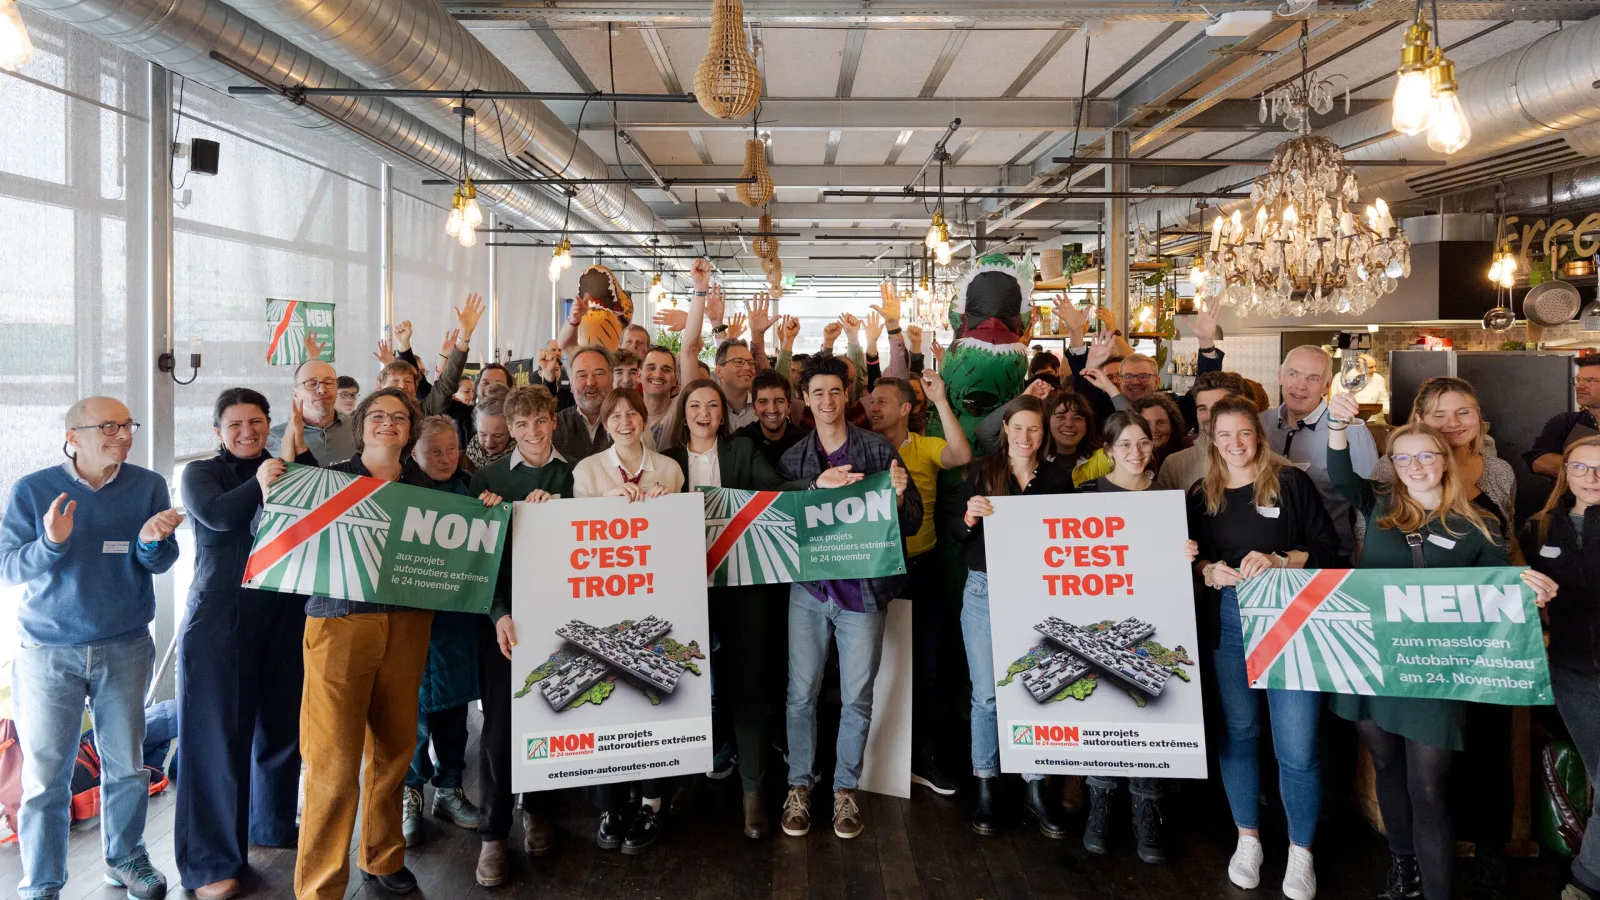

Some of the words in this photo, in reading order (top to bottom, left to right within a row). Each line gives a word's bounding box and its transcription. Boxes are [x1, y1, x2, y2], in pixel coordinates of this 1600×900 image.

[305, 309, 332, 327] NEIN
[804, 489, 892, 529] NON
[400, 506, 501, 555] NON
[571, 517, 649, 541] TROP
[1042, 516, 1125, 540] TROP
[809, 534, 824, 542] aux
[825, 532, 853, 543] projets
[810, 542, 859, 552] autoroutiers
[860, 540, 896, 550] extrêmes
[396, 552, 413, 561] aux
[413, 554, 445, 566] projets
[570, 545, 652, 570] C'EST
[810, 554, 818, 563] le
[819, 554, 830, 562] 24
[831, 553, 871, 562] novembre
[1043, 545, 1129, 568] C'EST
[391, 574, 400, 584] le
[401, 576, 413, 585] 24
[414, 579, 460, 591] novembre
[393, 564, 448, 578] autoroutiers
[450, 572, 489, 583] extrêmes
[568, 573, 654, 598] TROP!
[1042, 573, 1134, 596] TROP!
[1383, 584, 1526, 624] NEIN
[1391, 637, 1424, 647] zum
[1427, 636, 1511, 649] masslosen
[1396, 653, 1535, 670] Autobahn-Ausbau
[1399, 673, 1423, 684] am
[1425, 672, 1449, 684] 24.
[1452, 672, 1536, 690] November
[550, 732, 595, 752] NON
[597, 734, 616, 742] aux
[617, 729, 653, 741] projets
[1034, 725, 1079, 741] NON
[1102, 729, 1140, 739] projets
[597, 740, 660, 752] autoroutiers
[661, 734, 707, 746] extrêmes
[1082, 738, 1147, 747] autoroutiers
[1149, 740, 1199, 749] extrêmes
[564, 749, 594, 757] novembre
[548, 758, 680, 779] extension-autoroutes-non.ch
[1034, 758, 1170, 769] extension-autoroutes-non.ch
